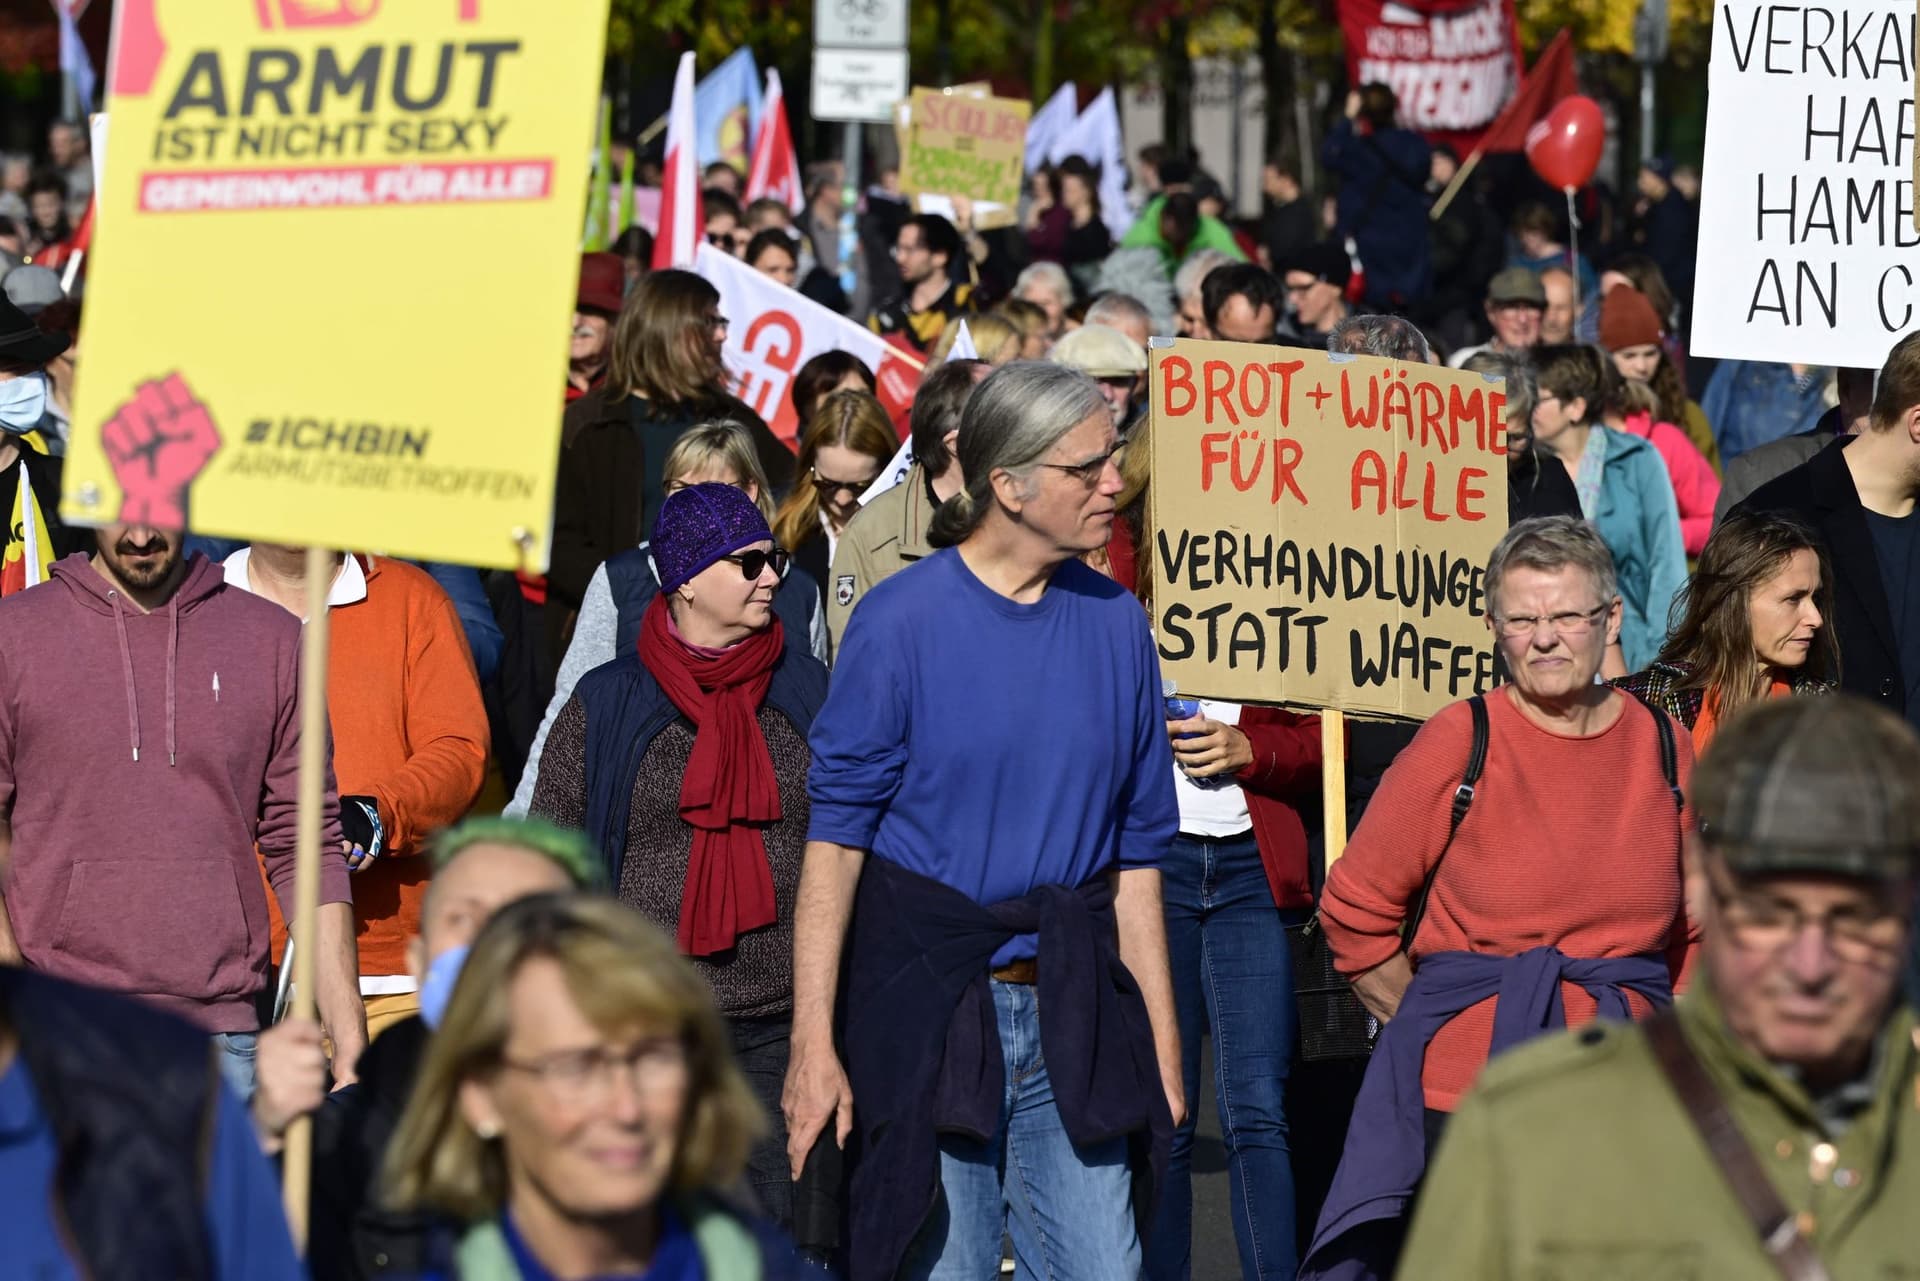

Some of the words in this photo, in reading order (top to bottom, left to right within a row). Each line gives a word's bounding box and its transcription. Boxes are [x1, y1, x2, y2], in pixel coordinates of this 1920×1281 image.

[163, 39, 521, 120] ARMUT
[152, 125, 228, 162] IST
[234, 121, 379, 159] NICHT
[384, 115, 510, 155] SEXY
[144, 174, 372, 211] GEMEINWOHL
[375, 163, 445, 201] FÜR
[446, 166, 546, 198] ALLE!
[1746, 258, 1838, 328] AN
[244, 417, 431, 459] #ICHBIN
[225, 451, 540, 500] ARMUTSBETROFFEN
[1200, 429, 1308, 506] FÜR
[1351, 449, 1489, 522] ALLE
[1158, 602, 1329, 675] STATT
